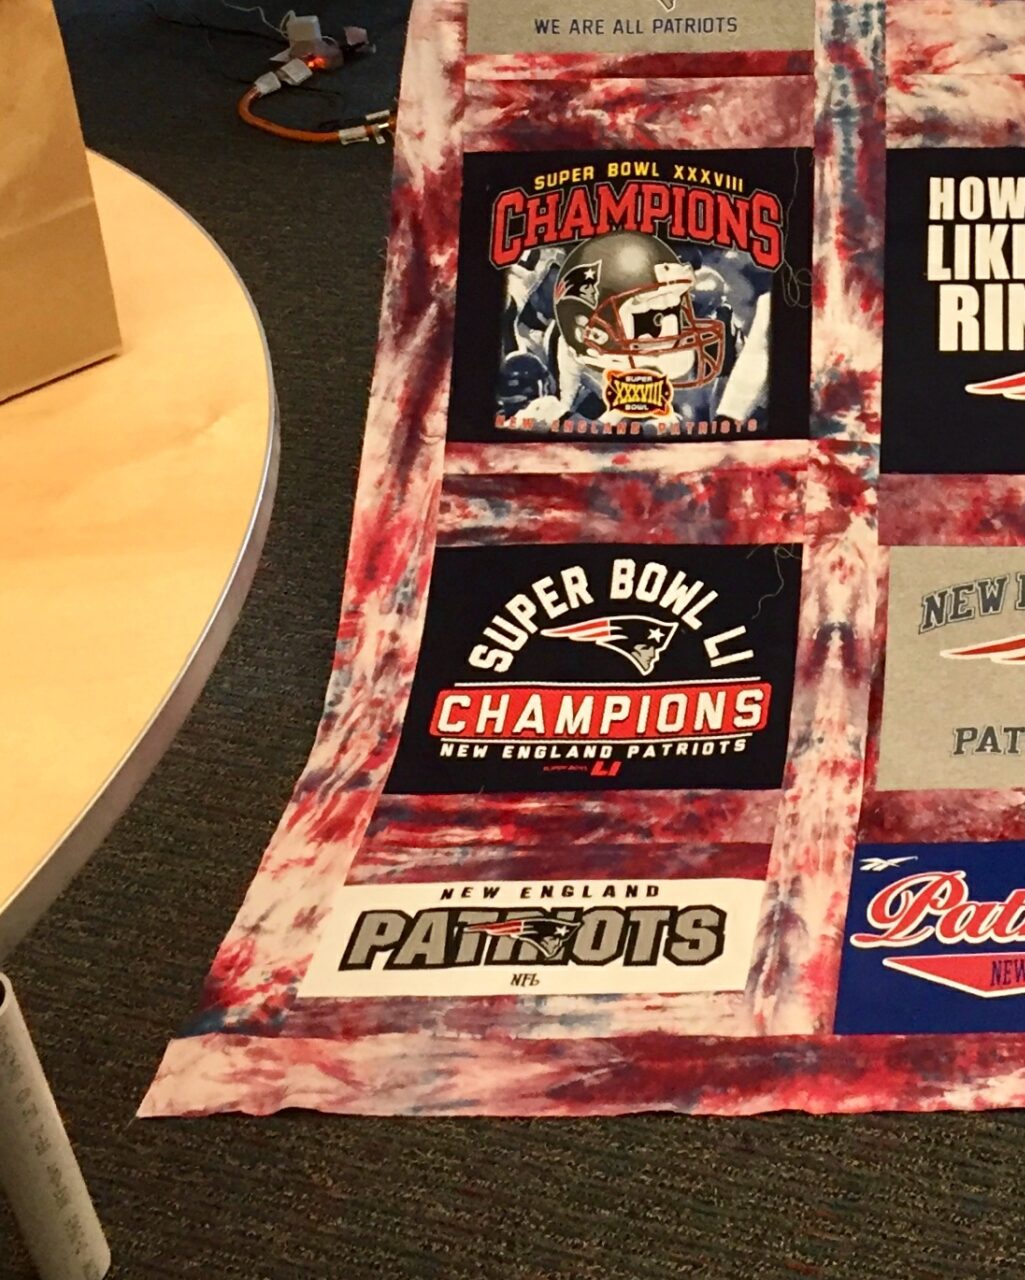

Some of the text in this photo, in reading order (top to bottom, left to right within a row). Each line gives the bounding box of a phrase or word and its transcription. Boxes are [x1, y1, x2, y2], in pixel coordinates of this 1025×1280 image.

[534, 17, 738, 35] WE ARE ALL PATRIOTS
[534, 162, 744, 192] SUPER BOWL XXXVIII
[489, 180, 784, 270] CHAMPIONS
[612, 380, 664, 406] XXXVIII
[495, 416, 758, 435] NEW ENGLAND PATRIOTS
[468, 558, 754, 673] SUPER BOWL LI
[918, 575, 1009, 634] NEW
[437, 688, 764, 735] CHAMPIONS
[440, 739, 747, 759] NEW ENGLAND PATRIOTS
[440, 885, 660, 900] NEW ENGLAND
[510, 973, 540, 987] NFL
